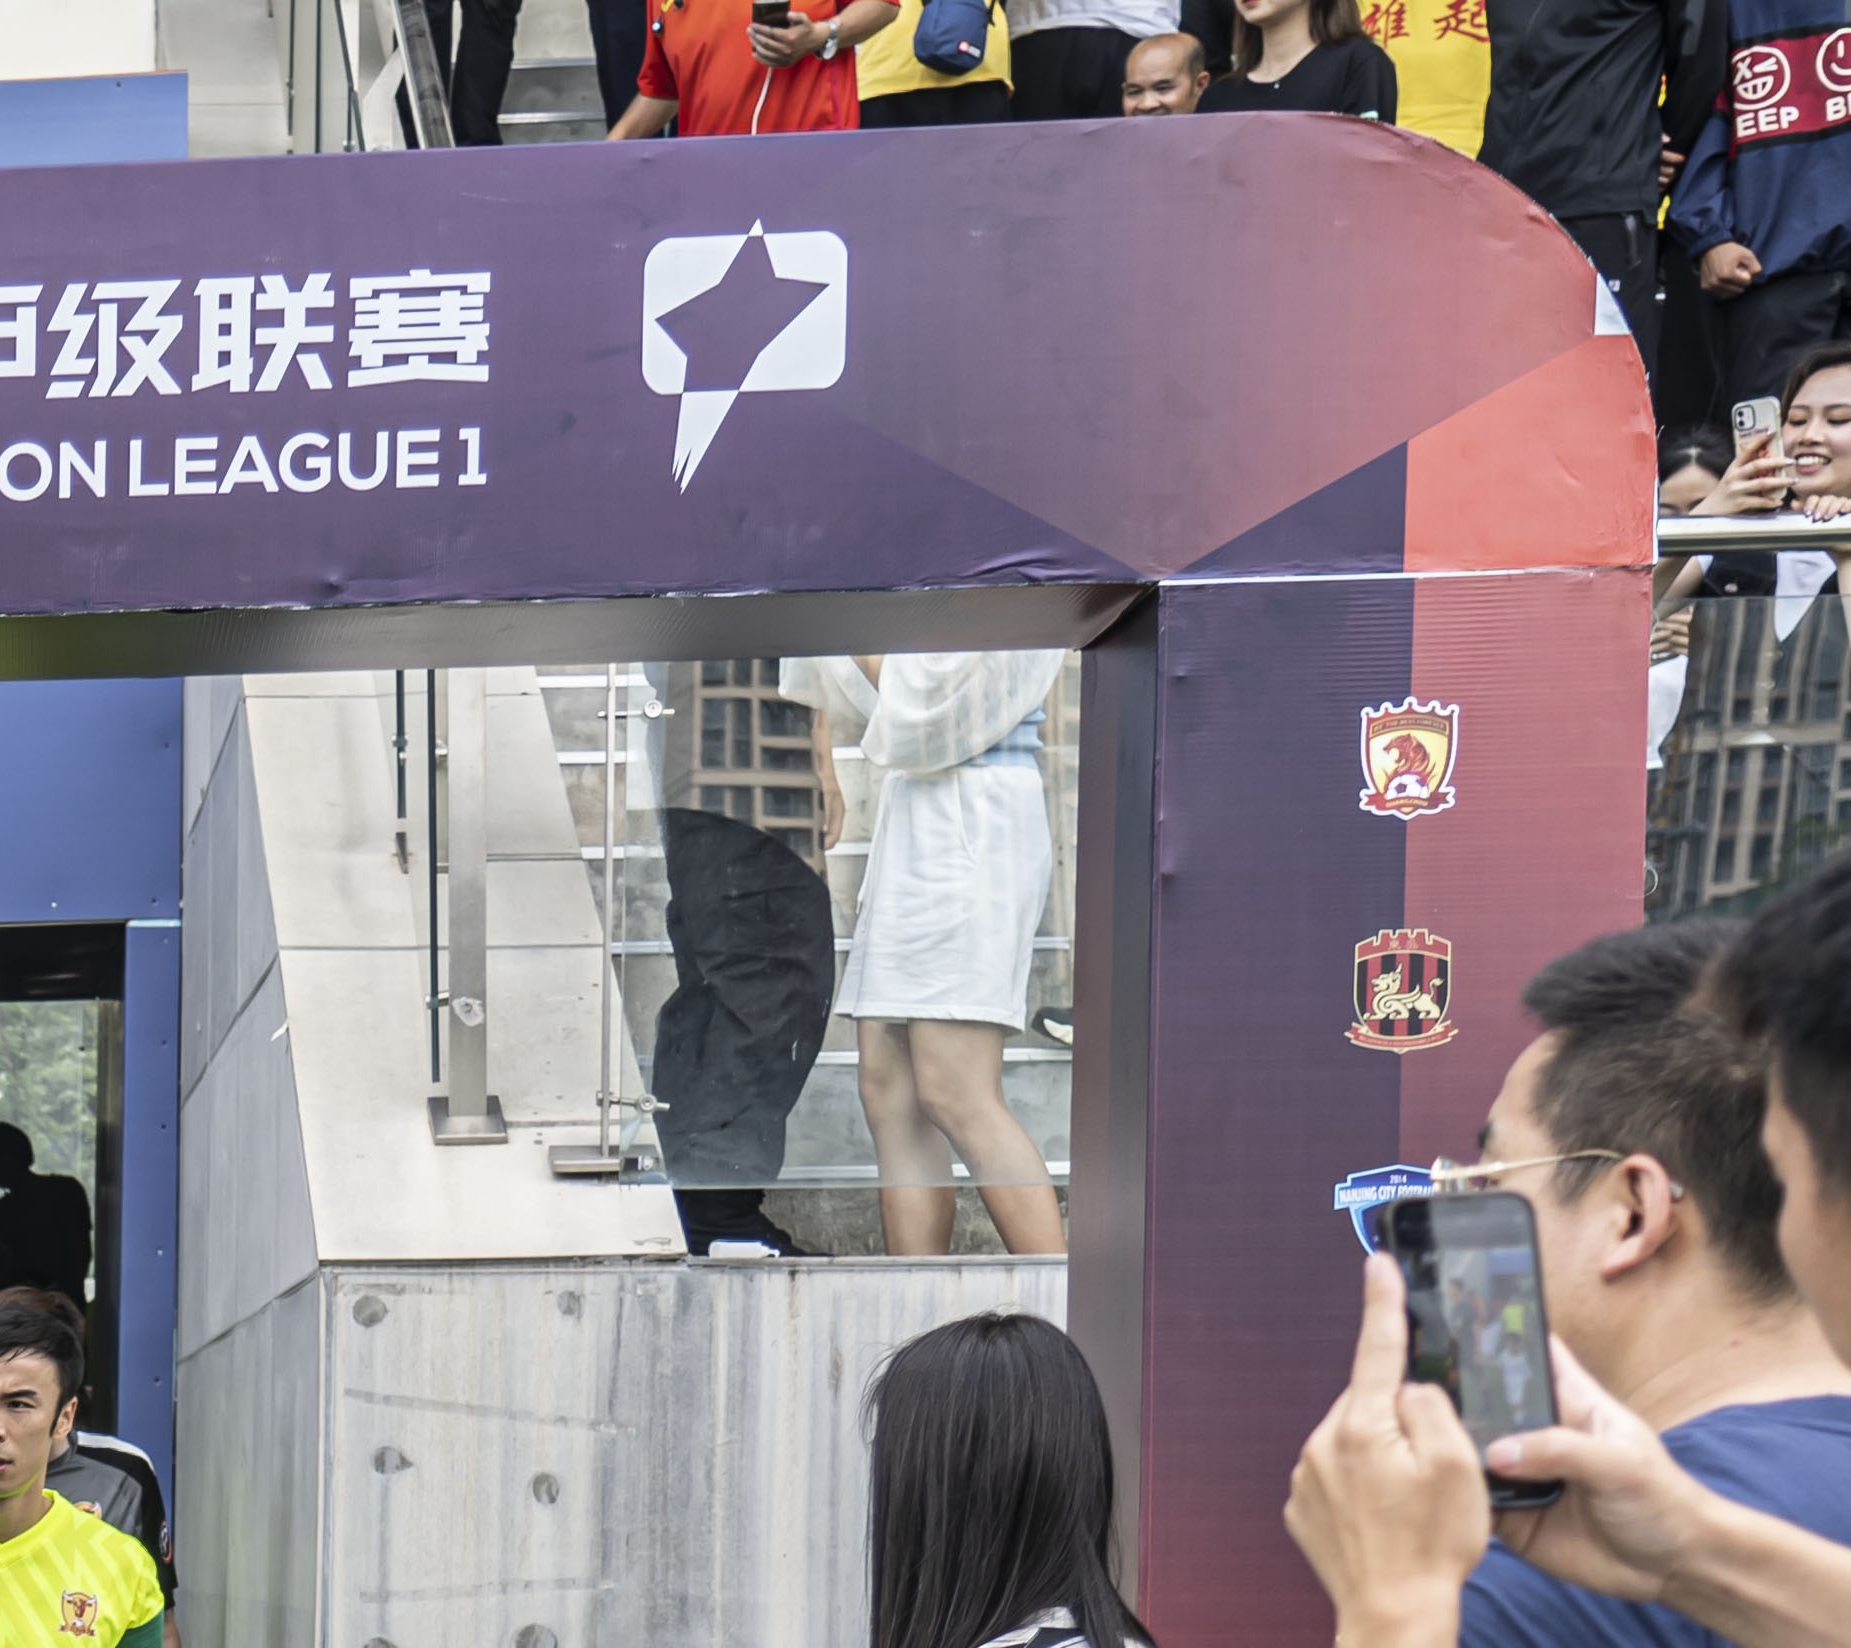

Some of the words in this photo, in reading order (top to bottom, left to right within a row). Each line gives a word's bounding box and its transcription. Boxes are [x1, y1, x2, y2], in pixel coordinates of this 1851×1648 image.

[1826, 95, 1851, 122] B
[128, 429, 441, 497] LEAGUE
[458, 427, 487, 486] 1
